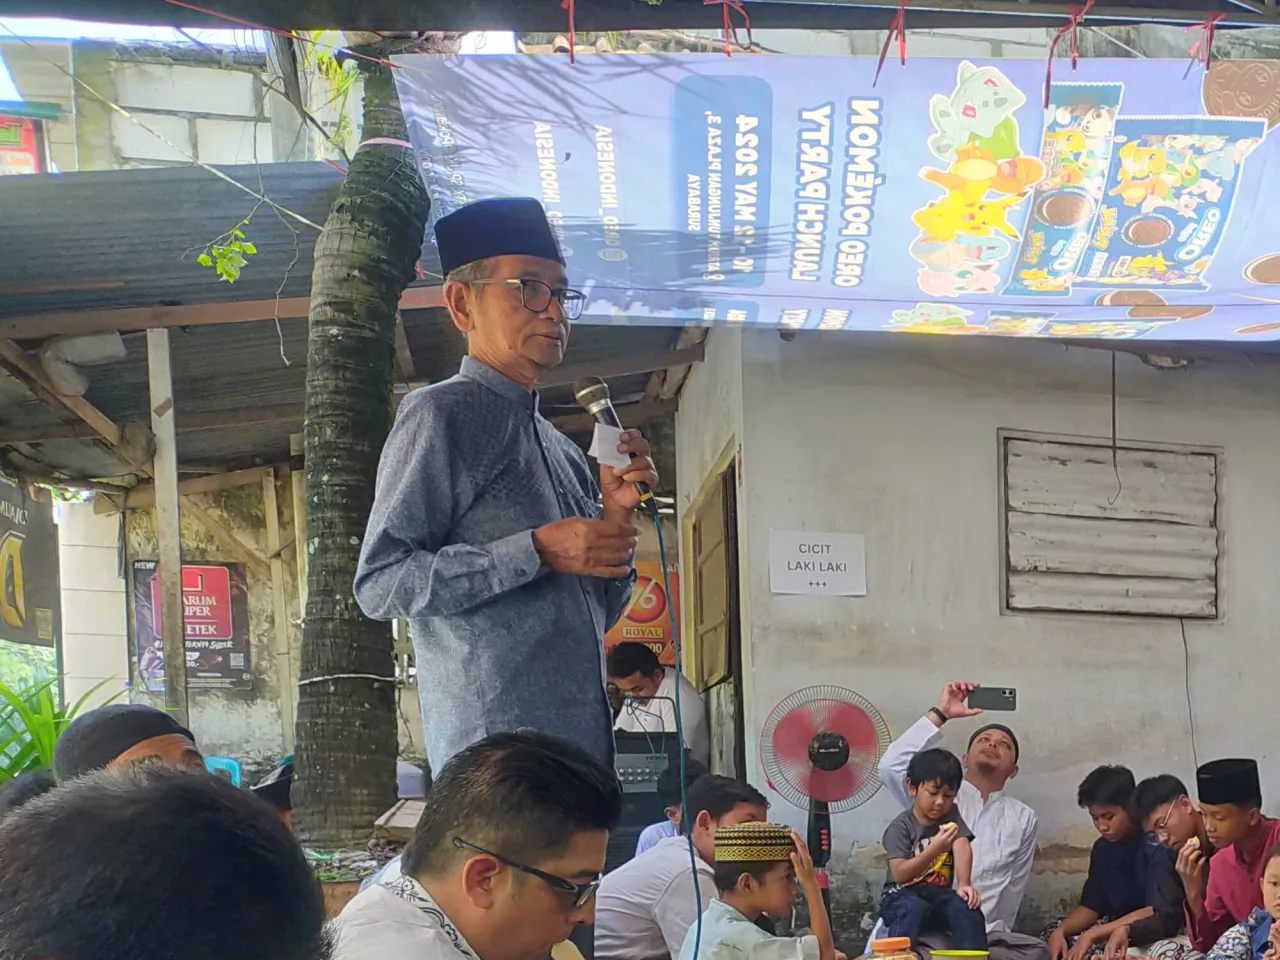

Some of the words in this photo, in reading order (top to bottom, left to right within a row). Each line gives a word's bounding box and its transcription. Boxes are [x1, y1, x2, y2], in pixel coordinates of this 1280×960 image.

[798, 543, 832, 554] CICIT
[134, 561, 156, 570] NEW
[787, 560, 816, 571] LAKI
[819, 561, 847, 572] LAKI
[186, 624, 218, 635] ETEK
[625, 628, 662, 637] ROYAL
